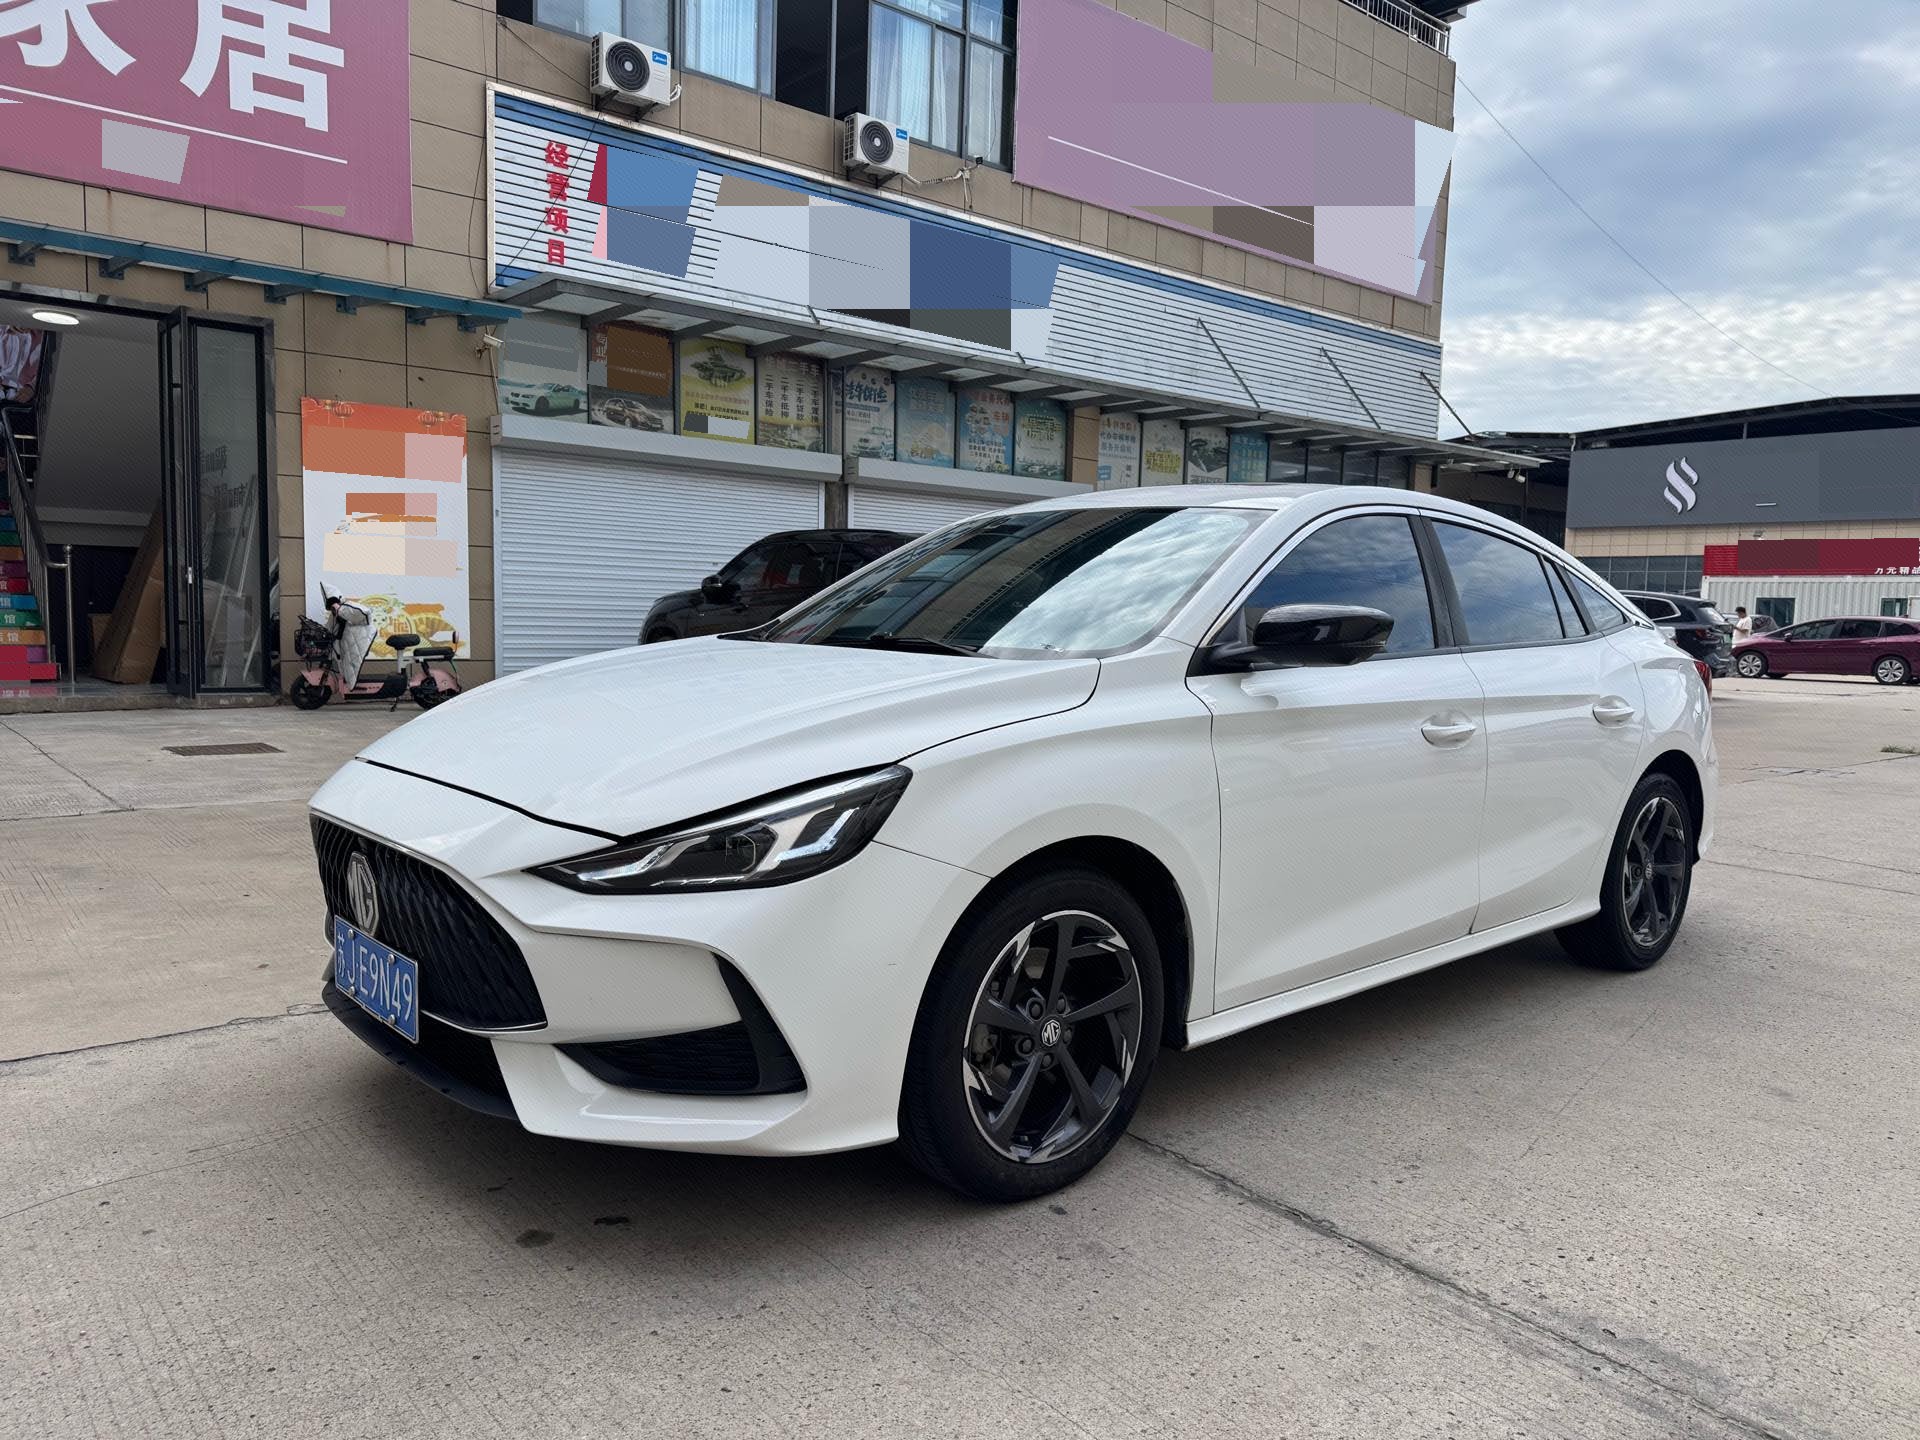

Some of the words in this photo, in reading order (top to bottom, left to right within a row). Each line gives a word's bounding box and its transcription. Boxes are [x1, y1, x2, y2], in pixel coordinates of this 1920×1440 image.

[545, 140, 570, 266] 经营项目
[347, 858, 377, 932] MG
[1043, 1021, 1060, 1044] MG
